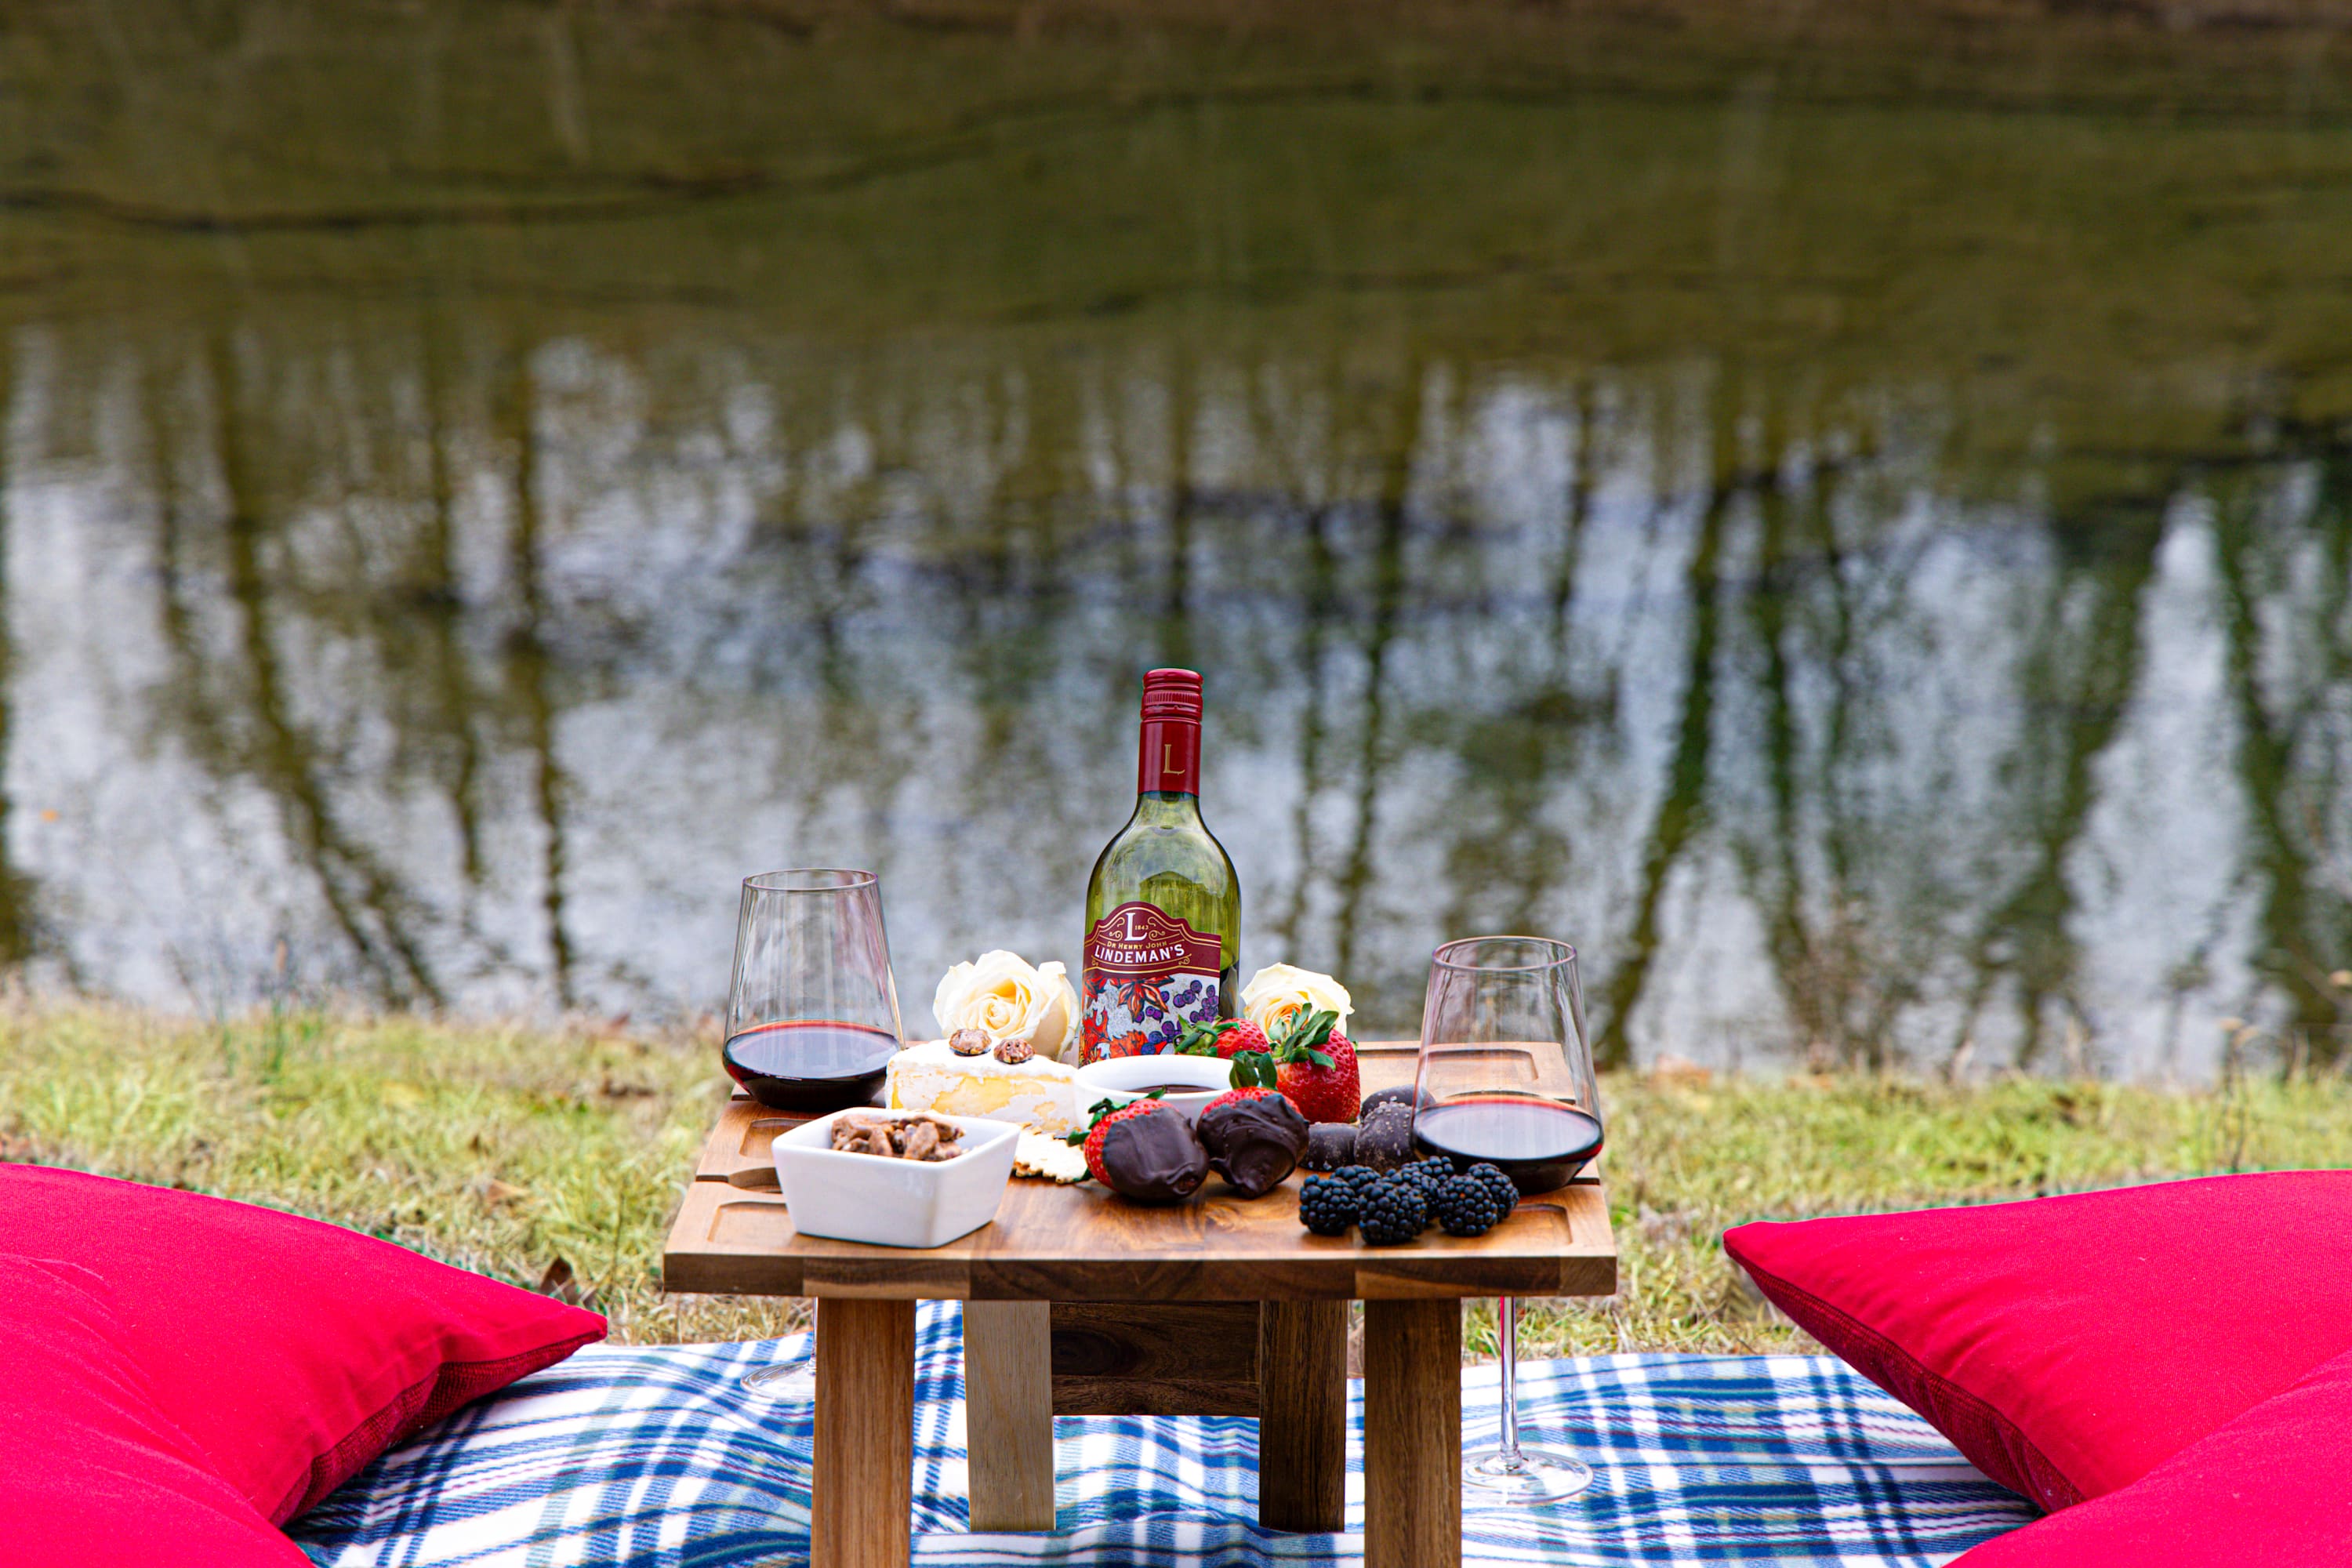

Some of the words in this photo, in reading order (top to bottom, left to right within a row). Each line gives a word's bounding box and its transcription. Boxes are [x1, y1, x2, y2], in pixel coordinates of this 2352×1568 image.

[1163, 744, 1185, 775] L
[1124, 913, 1147, 942] L
[1094, 944, 1185, 964] LINDEMAN'S
